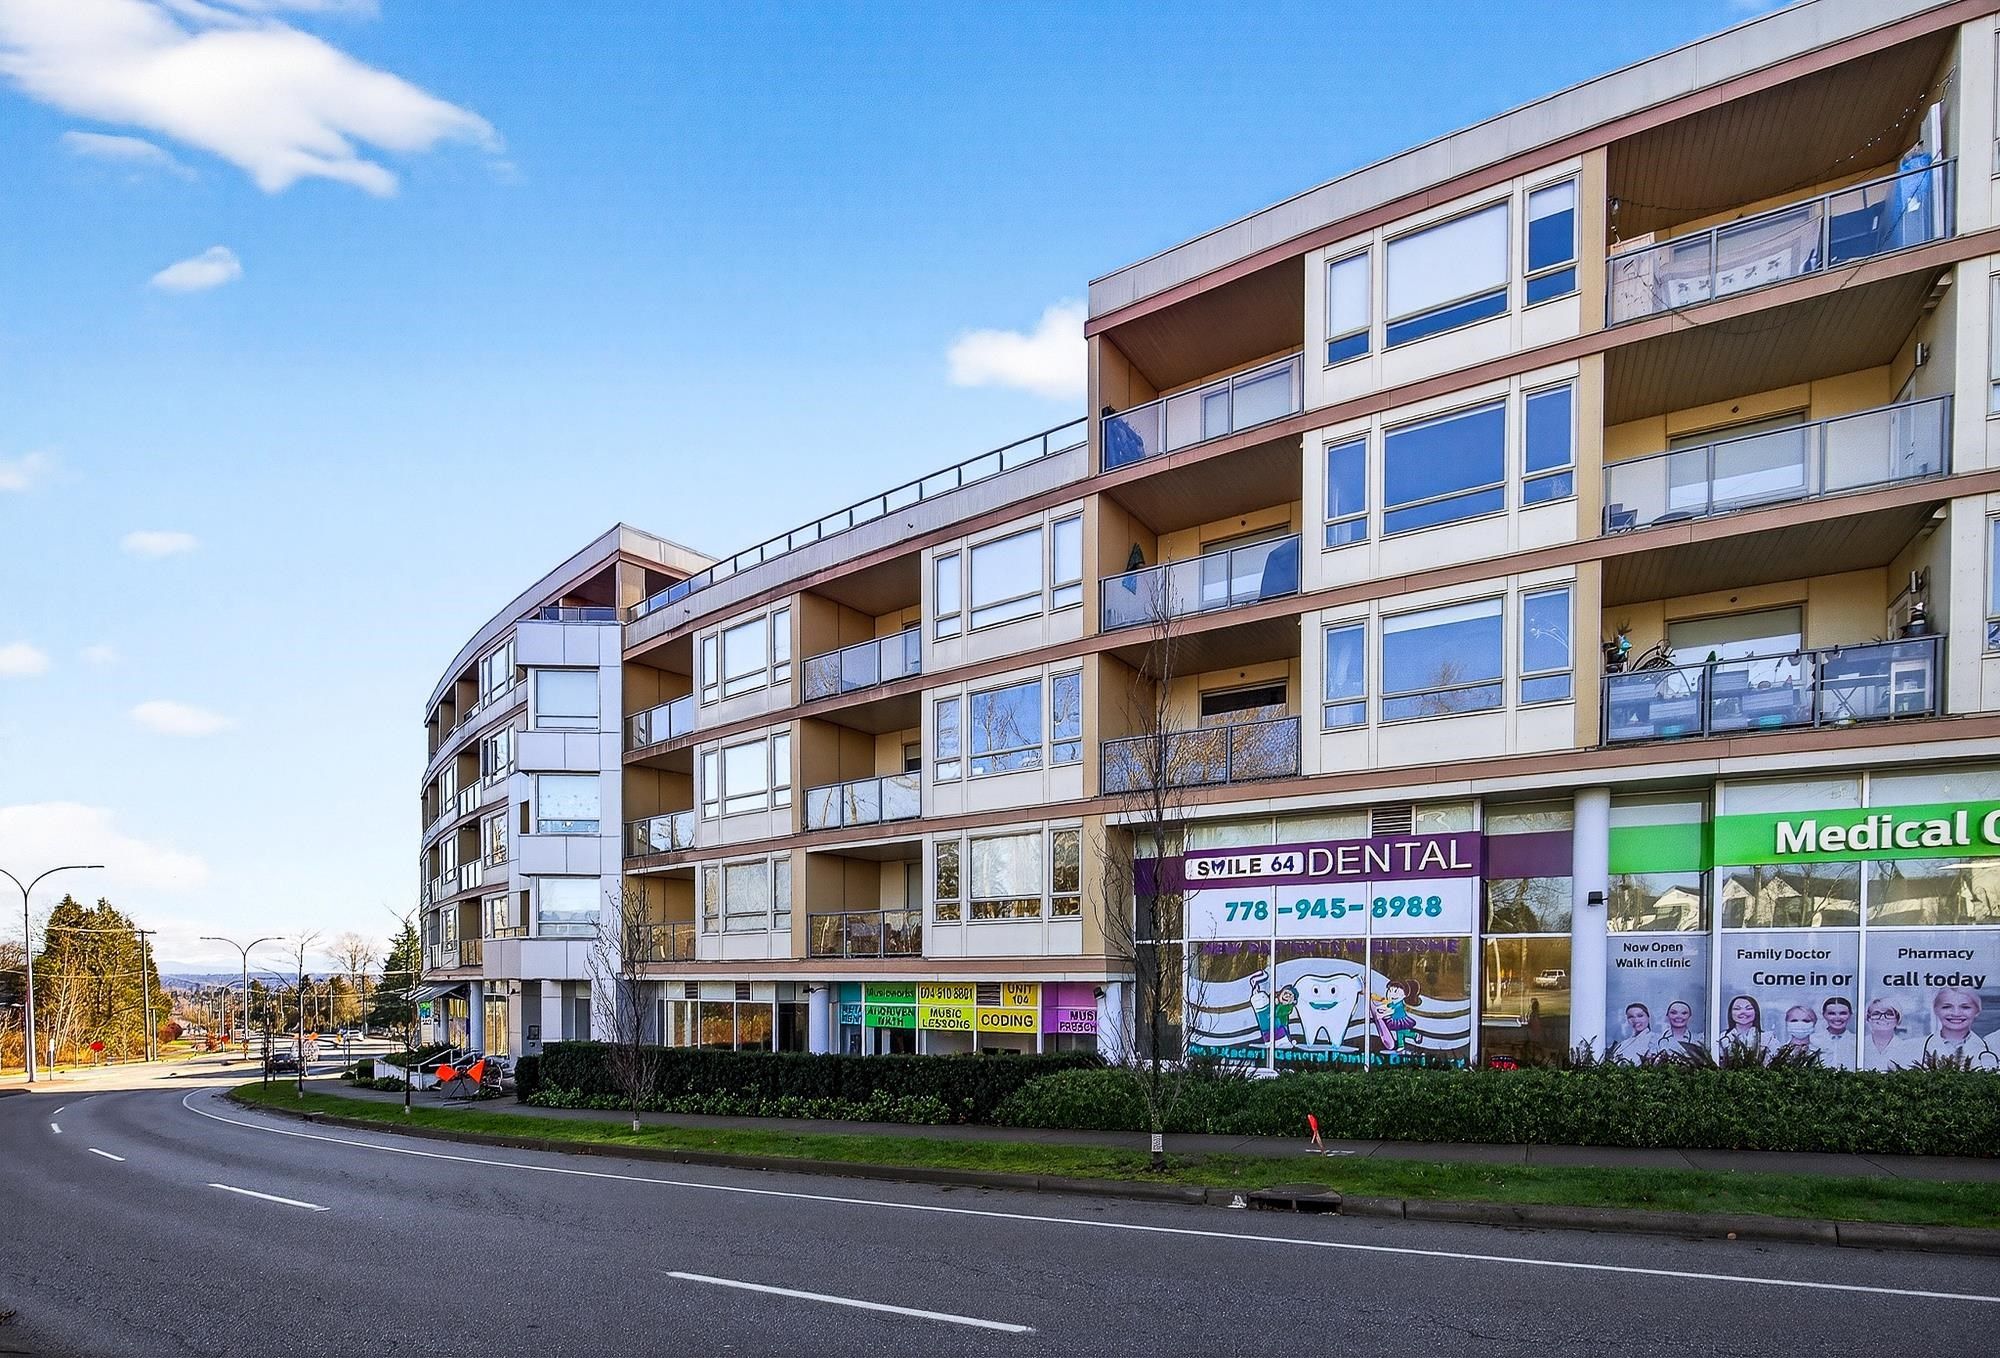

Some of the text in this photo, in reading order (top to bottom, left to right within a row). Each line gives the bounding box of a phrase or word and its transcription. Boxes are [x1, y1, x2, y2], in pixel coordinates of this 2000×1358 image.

[1776, 811, 1969, 854] Medical
[1197, 839, 1472, 876] SMILE 64 DENTAL
[1623, 942, 1683, 955] Now Open
[1737, 948, 1831, 962] Family Doctor
[1898, 948, 1974, 962] Pharmacy
[1616, 957, 1692, 968] Walk in clinic
[1752, 971, 1853, 986] Come in or
[1882, 972, 1986, 990] call today
[1007, 984, 1032, 994] UNIT
[930, 1008, 962, 1018] MUSIC
[1070, 1010, 1097, 1021] MUSI
[981, 1014, 1033, 1027] CODING
